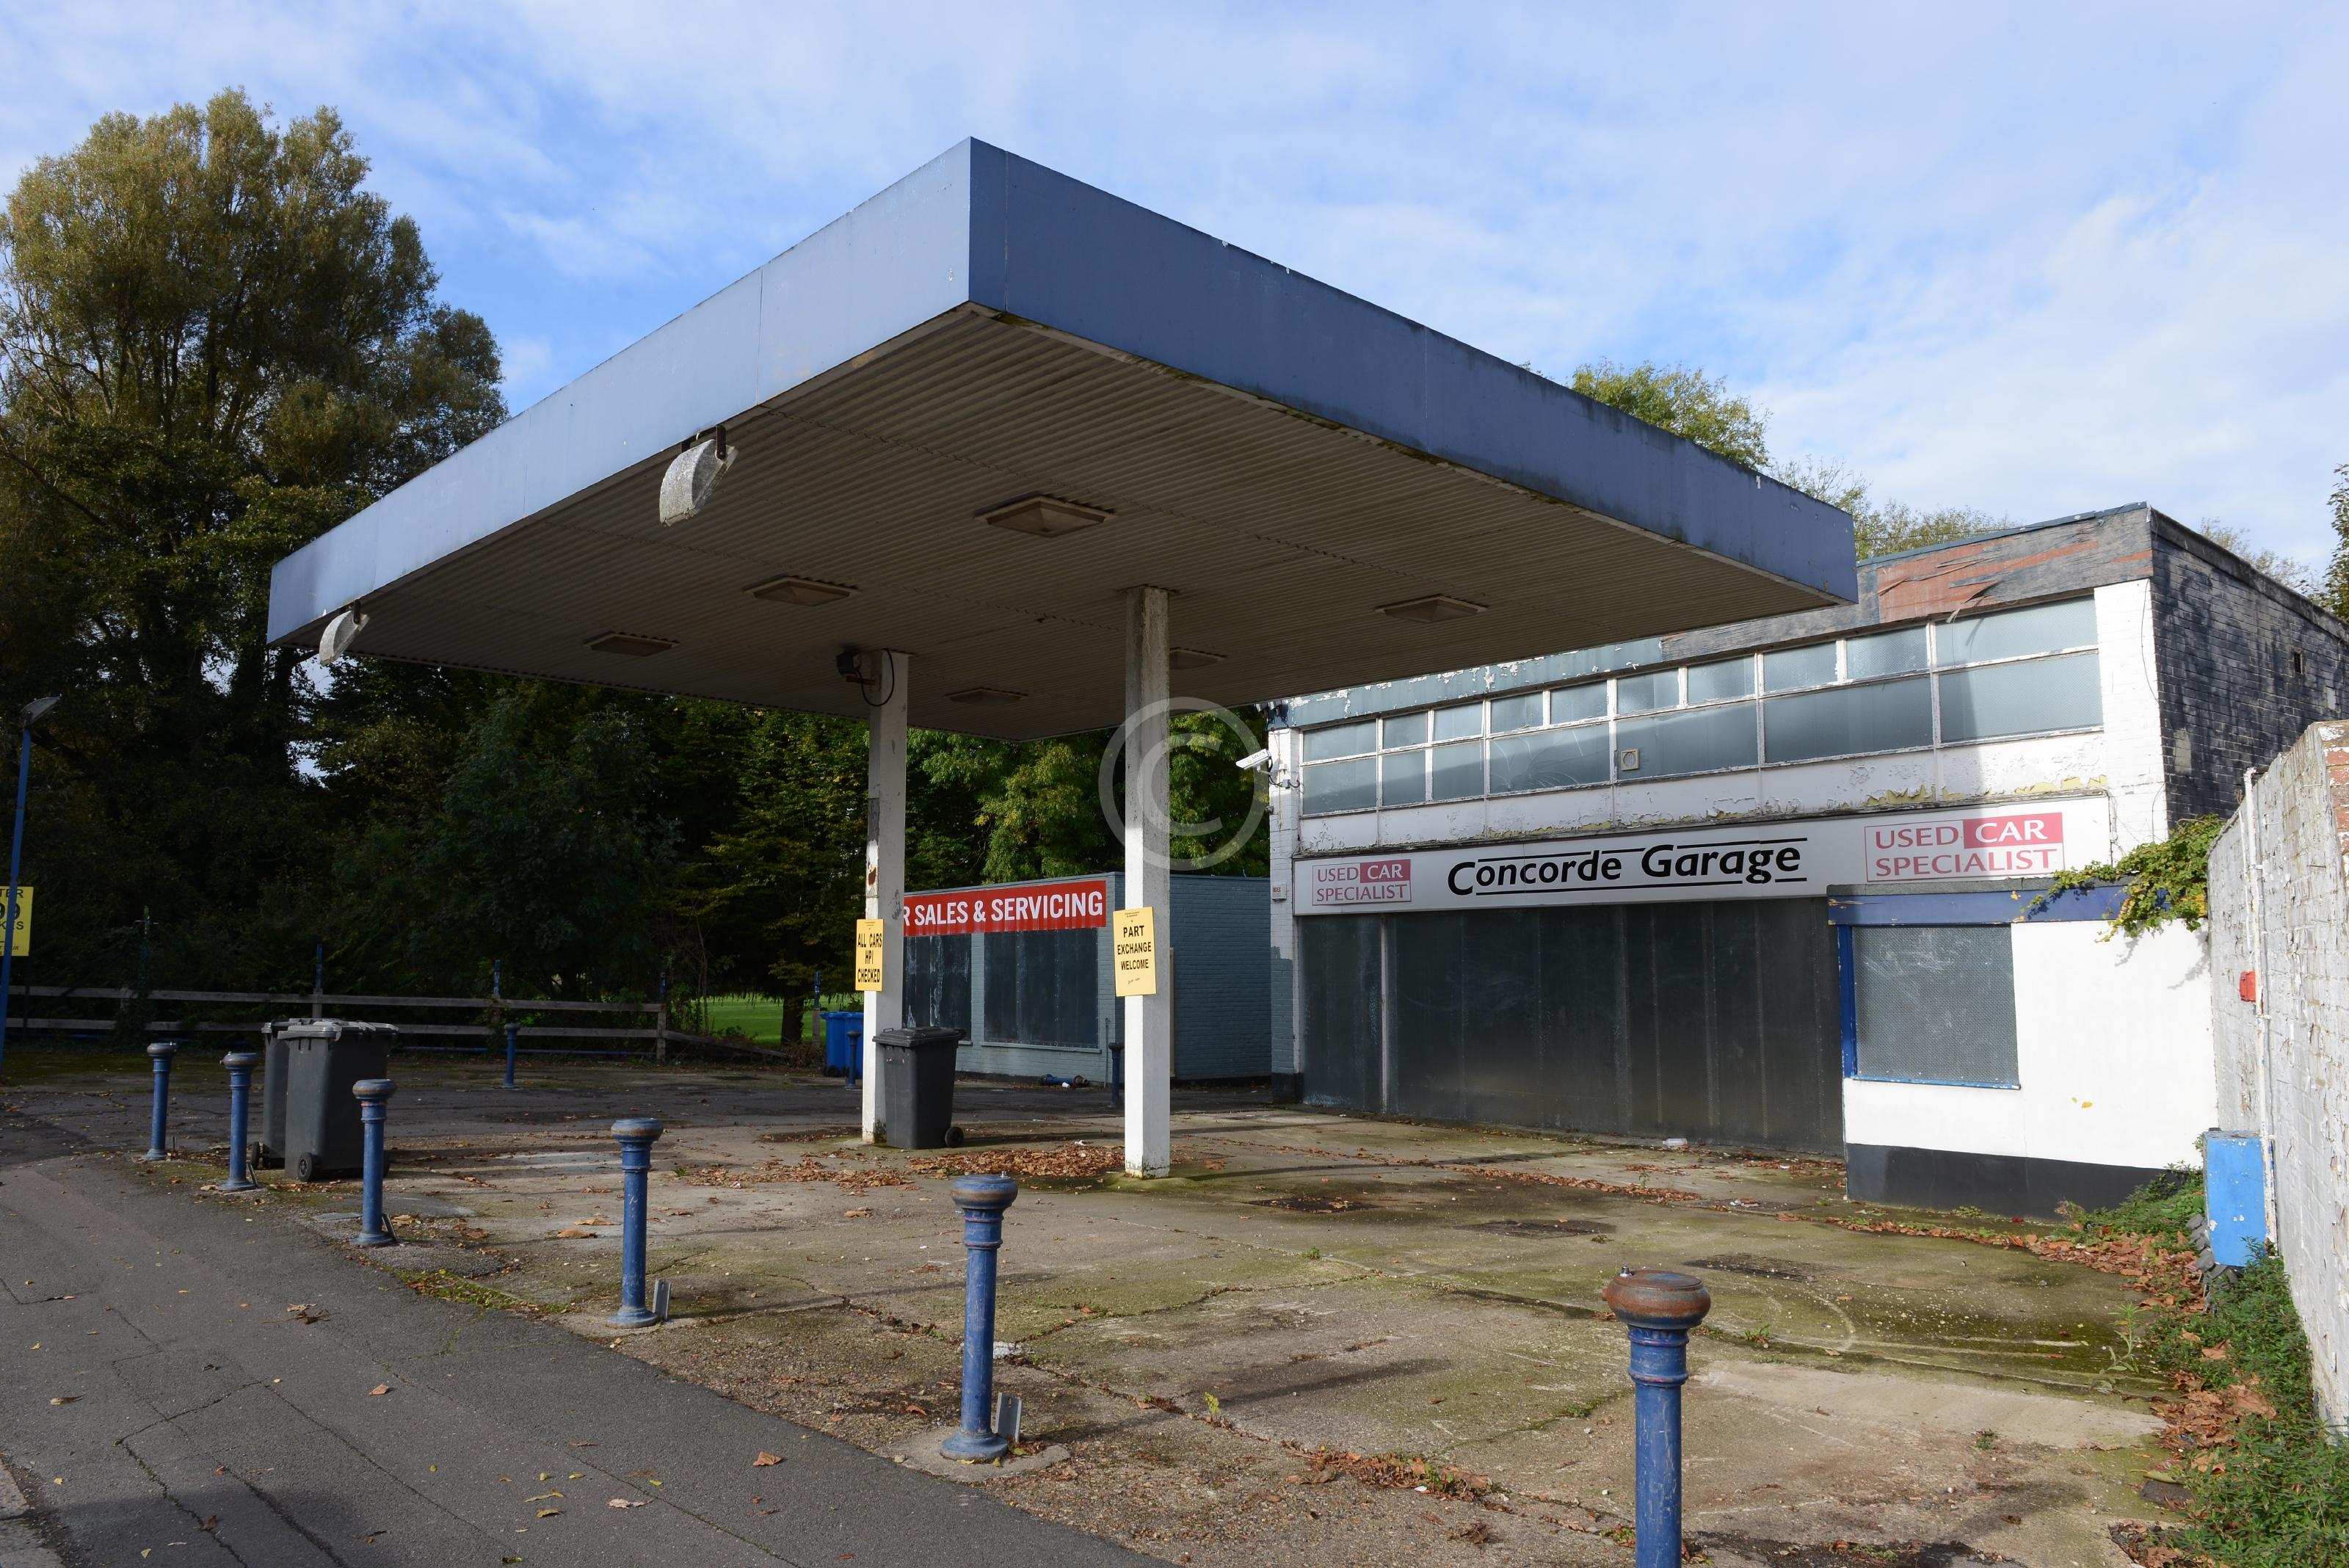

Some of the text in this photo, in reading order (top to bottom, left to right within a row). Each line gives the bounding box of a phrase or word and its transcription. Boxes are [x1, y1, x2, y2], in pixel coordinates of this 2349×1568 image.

[1876, 819, 2048, 849] USED CAR
[1448, 844, 1801, 896] Concorde Garage
[1876, 848, 2058, 877] SPECIALIST
[1318, 863, 1404, 882] USED CAR
[1316, 884, 1407, 902] SPECIALIST
[914, 901, 968, 926] SALES
[973, 900, 987, 923] &
[991, 890, 1103, 921] SERVICING
[1123, 925, 1144, 938] PART
[857, 933, 882, 948] ALL CARS
[1117, 942, 1152, 955] EXCHANGE
[865, 950, 874, 964] HPI
[1121, 959, 1149, 970] WELCOME
[857, 968, 880, 983] CHECKED
